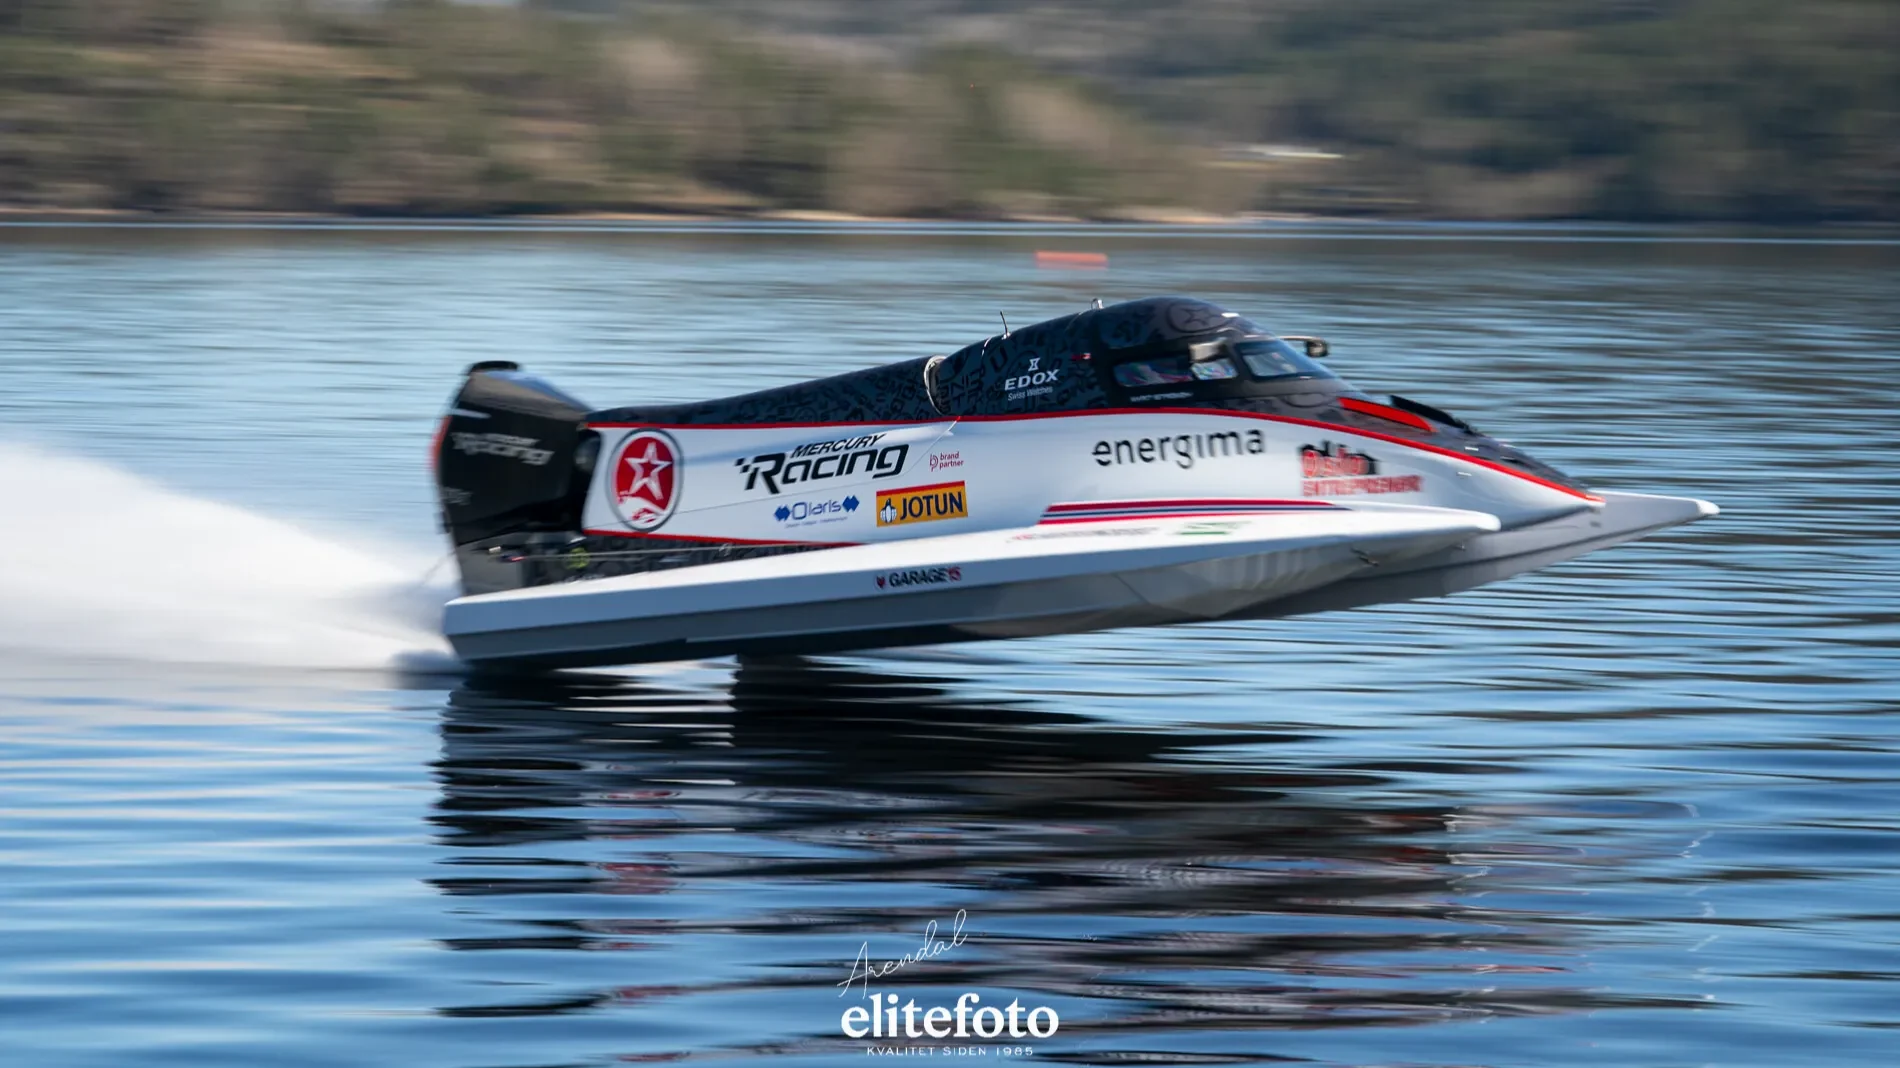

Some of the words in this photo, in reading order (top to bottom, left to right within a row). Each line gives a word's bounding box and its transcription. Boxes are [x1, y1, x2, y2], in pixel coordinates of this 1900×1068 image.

[1004, 369, 1060, 391] EDOX
[790, 433, 886, 459] MERCURY
[940, 451, 959, 461] brand
[1092, 428, 1265, 470] energima
[738, 444, 909, 495] Racing
[940, 460, 964, 471] partner
[900, 491, 963, 521] JOTUN
